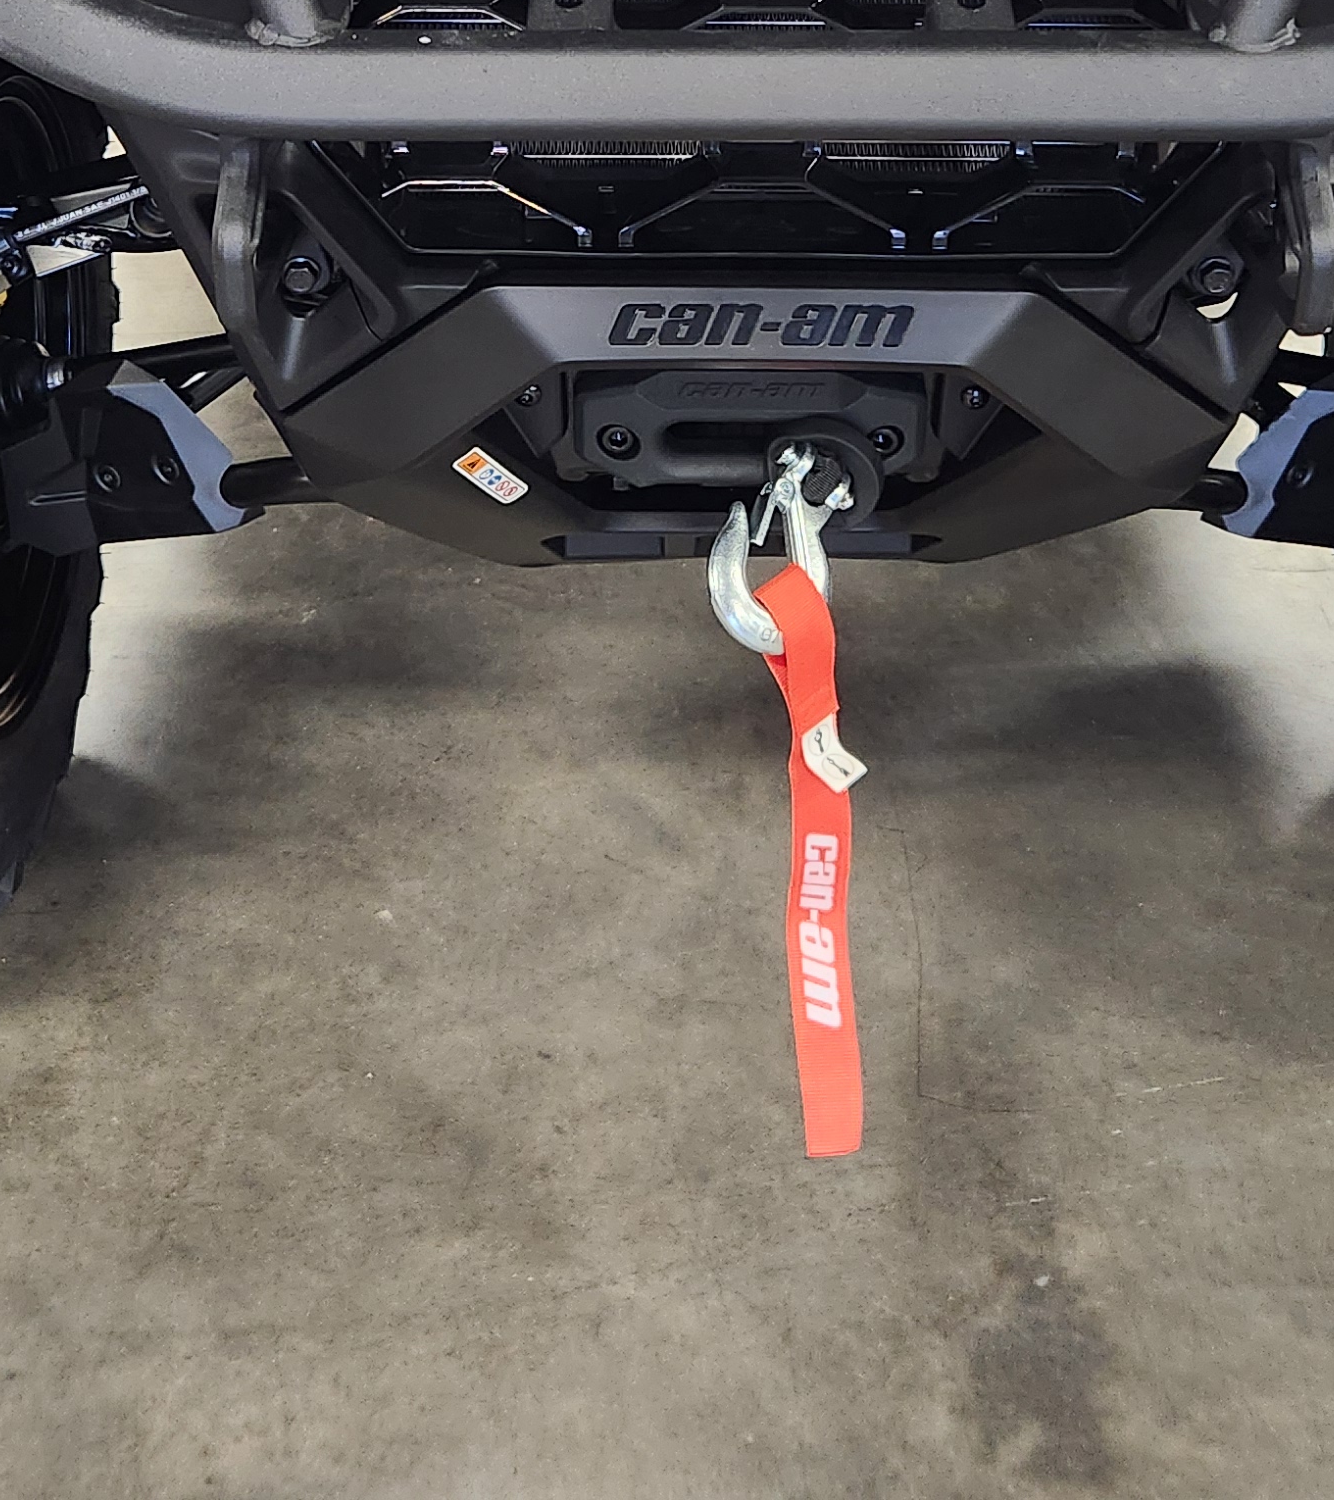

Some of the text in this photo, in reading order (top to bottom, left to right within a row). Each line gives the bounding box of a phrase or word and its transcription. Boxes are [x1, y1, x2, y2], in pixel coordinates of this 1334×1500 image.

[85, 200, 105, 213] SAE
[608, 303, 915, 347] can-am
[677, 381, 826, 398] can-am
[799, 832, 842, 1029] can-am
